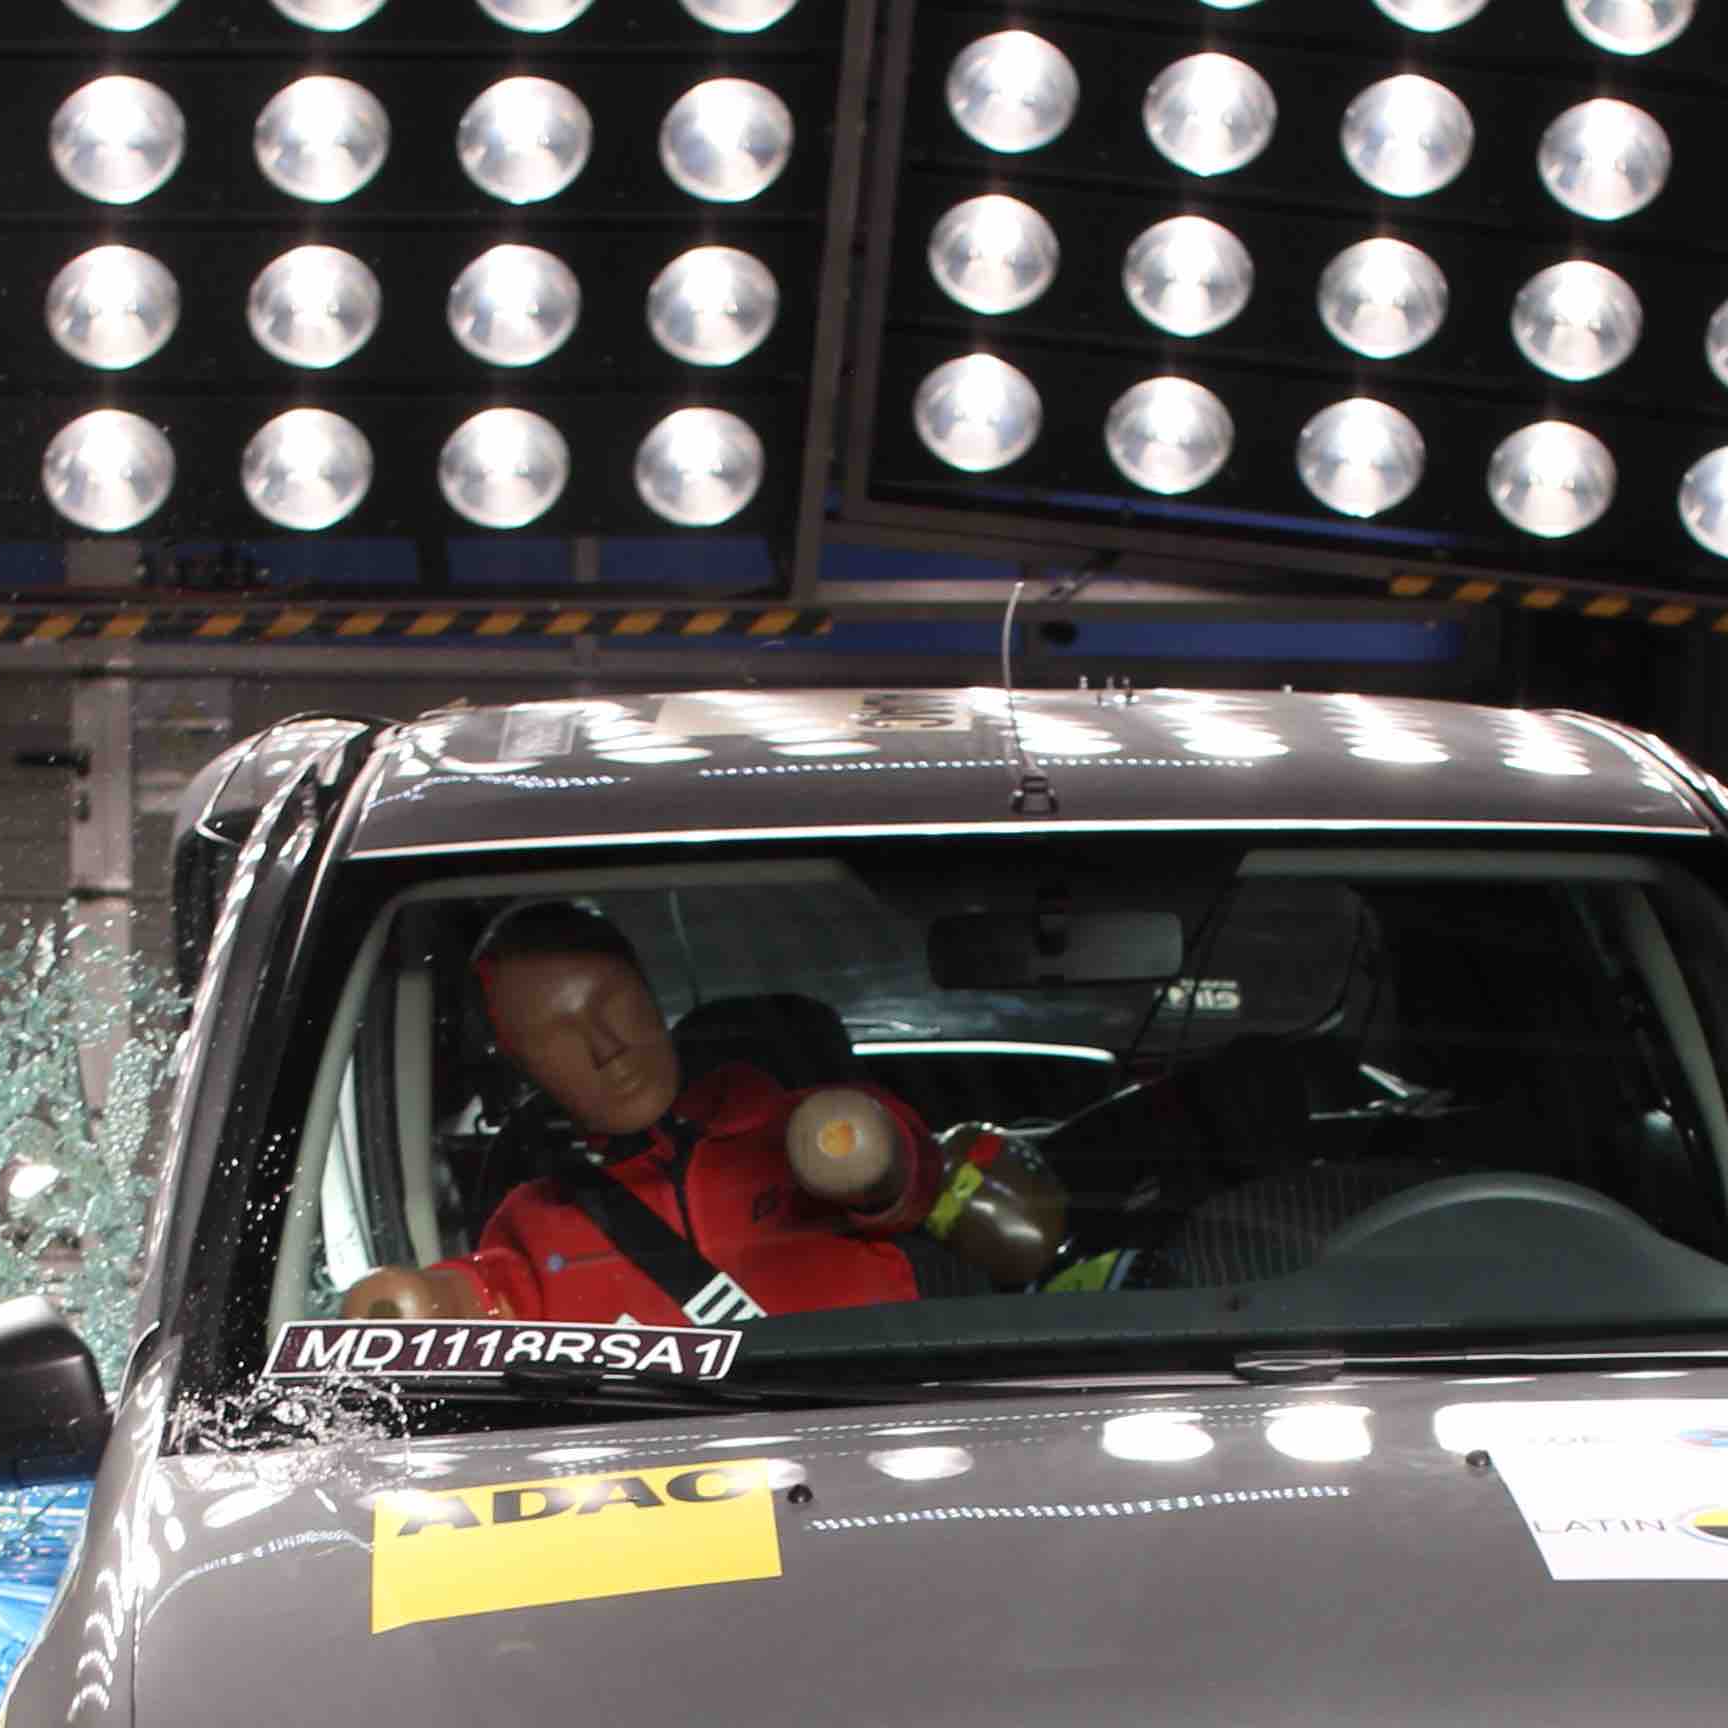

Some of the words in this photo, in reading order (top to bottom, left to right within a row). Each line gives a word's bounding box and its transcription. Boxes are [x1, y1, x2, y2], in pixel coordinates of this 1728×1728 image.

[296, 1327, 722, 1375] MD1118RSA1
[396, 1467, 749, 1537] ADAC
[1534, 1516, 1668, 1536] LATIN
